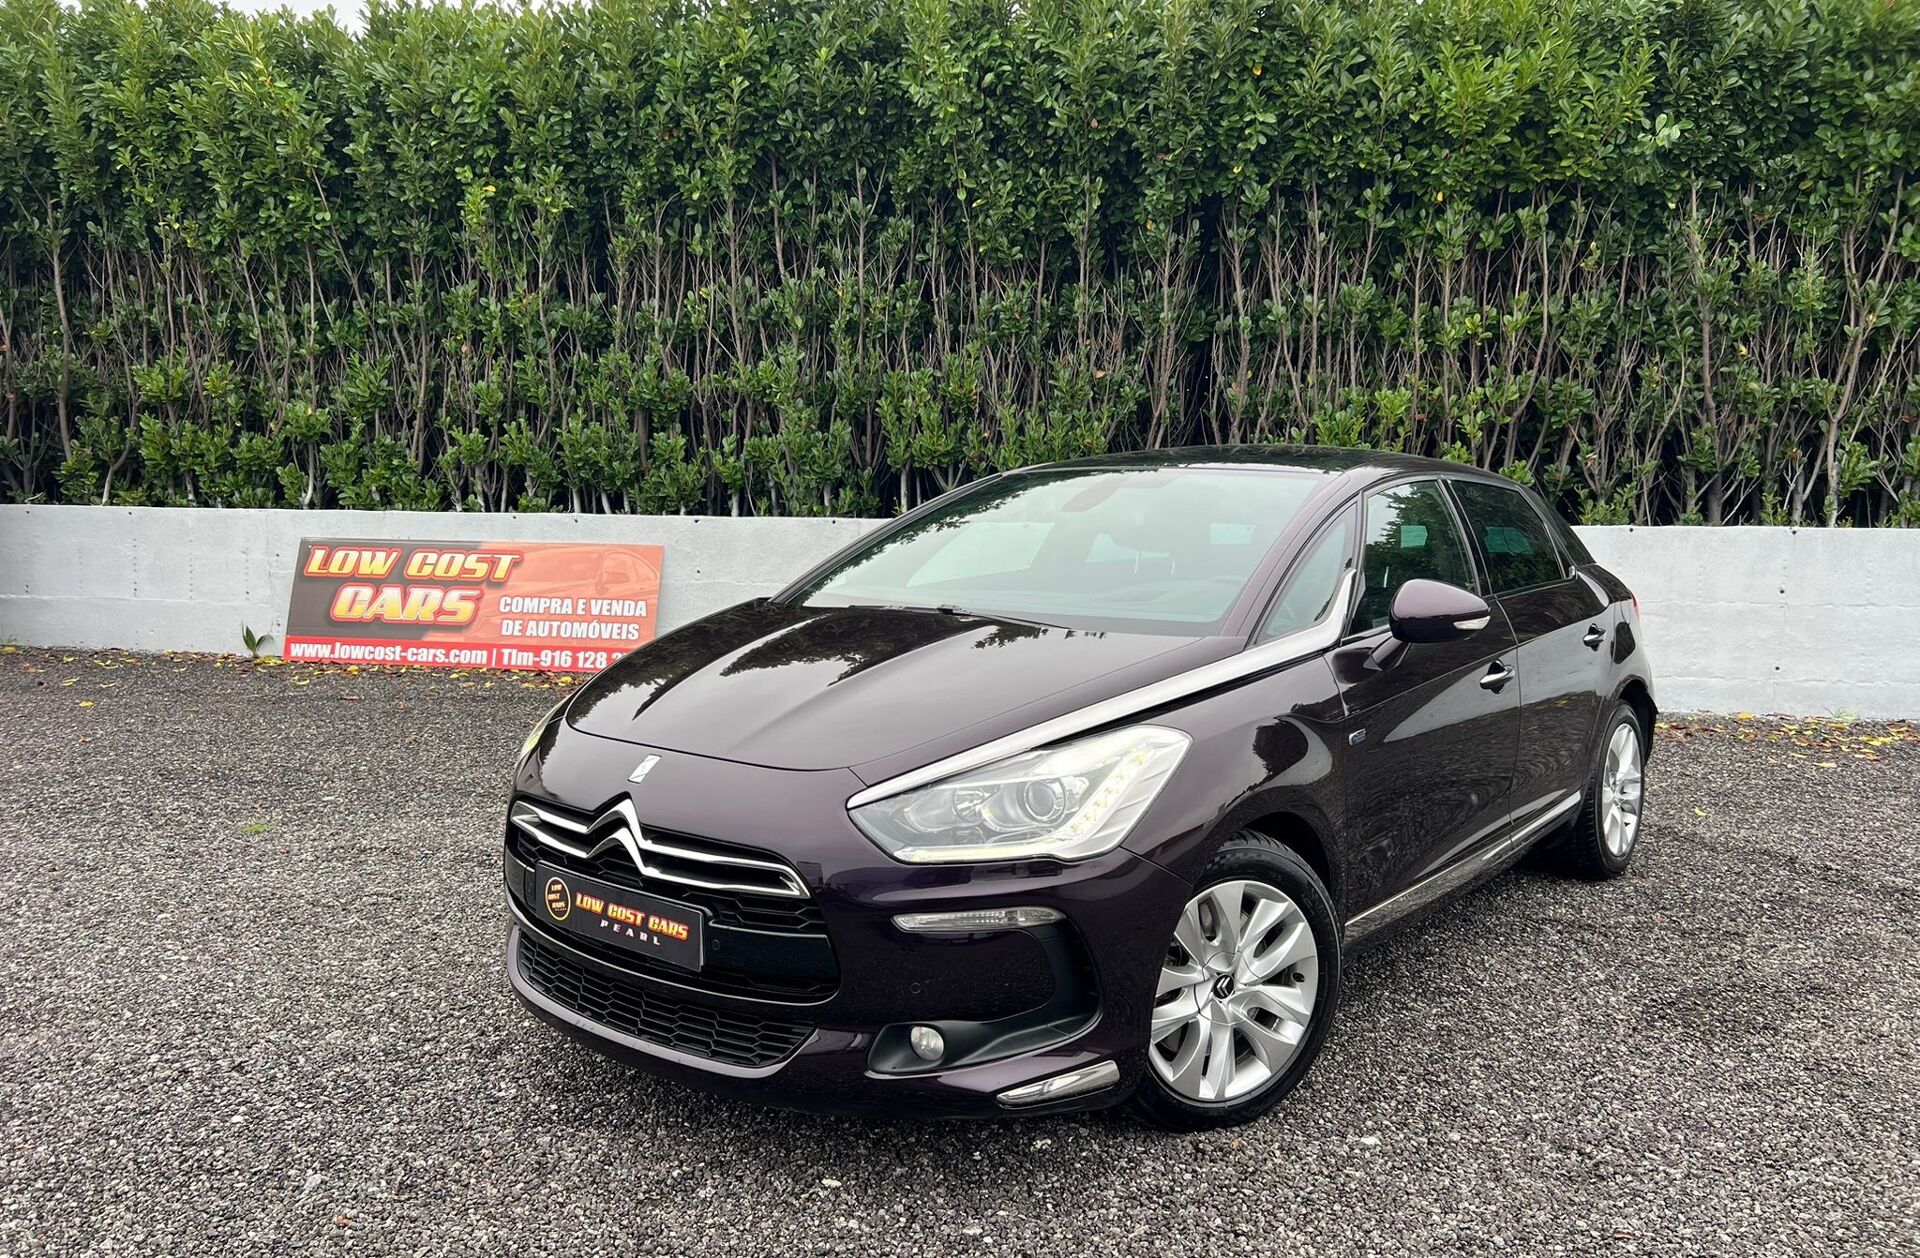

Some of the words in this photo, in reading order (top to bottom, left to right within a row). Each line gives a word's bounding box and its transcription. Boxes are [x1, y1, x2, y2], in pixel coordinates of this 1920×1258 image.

[305, 547, 402, 577] LOW
[405, 550, 523, 580] COST
[332, 584, 482, 623] CARS
[499, 596, 573, 615] COMPRA
[576, 599, 587, 615] E
[590, 600, 647, 617] VENDA
[501, 619, 523, 636] DE
[525, 620, 640, 640] AUTOMÓVEIS
[290, 642, 488, 665] www.lowcost-cars.com
[576, 651, 607, 669] 128
[575, 892, 604, 914] LOW
[607, 903, 645, 926] COST
[647, 914, 689, 941] CARS
[600, 919, 661, 945] PEARL
